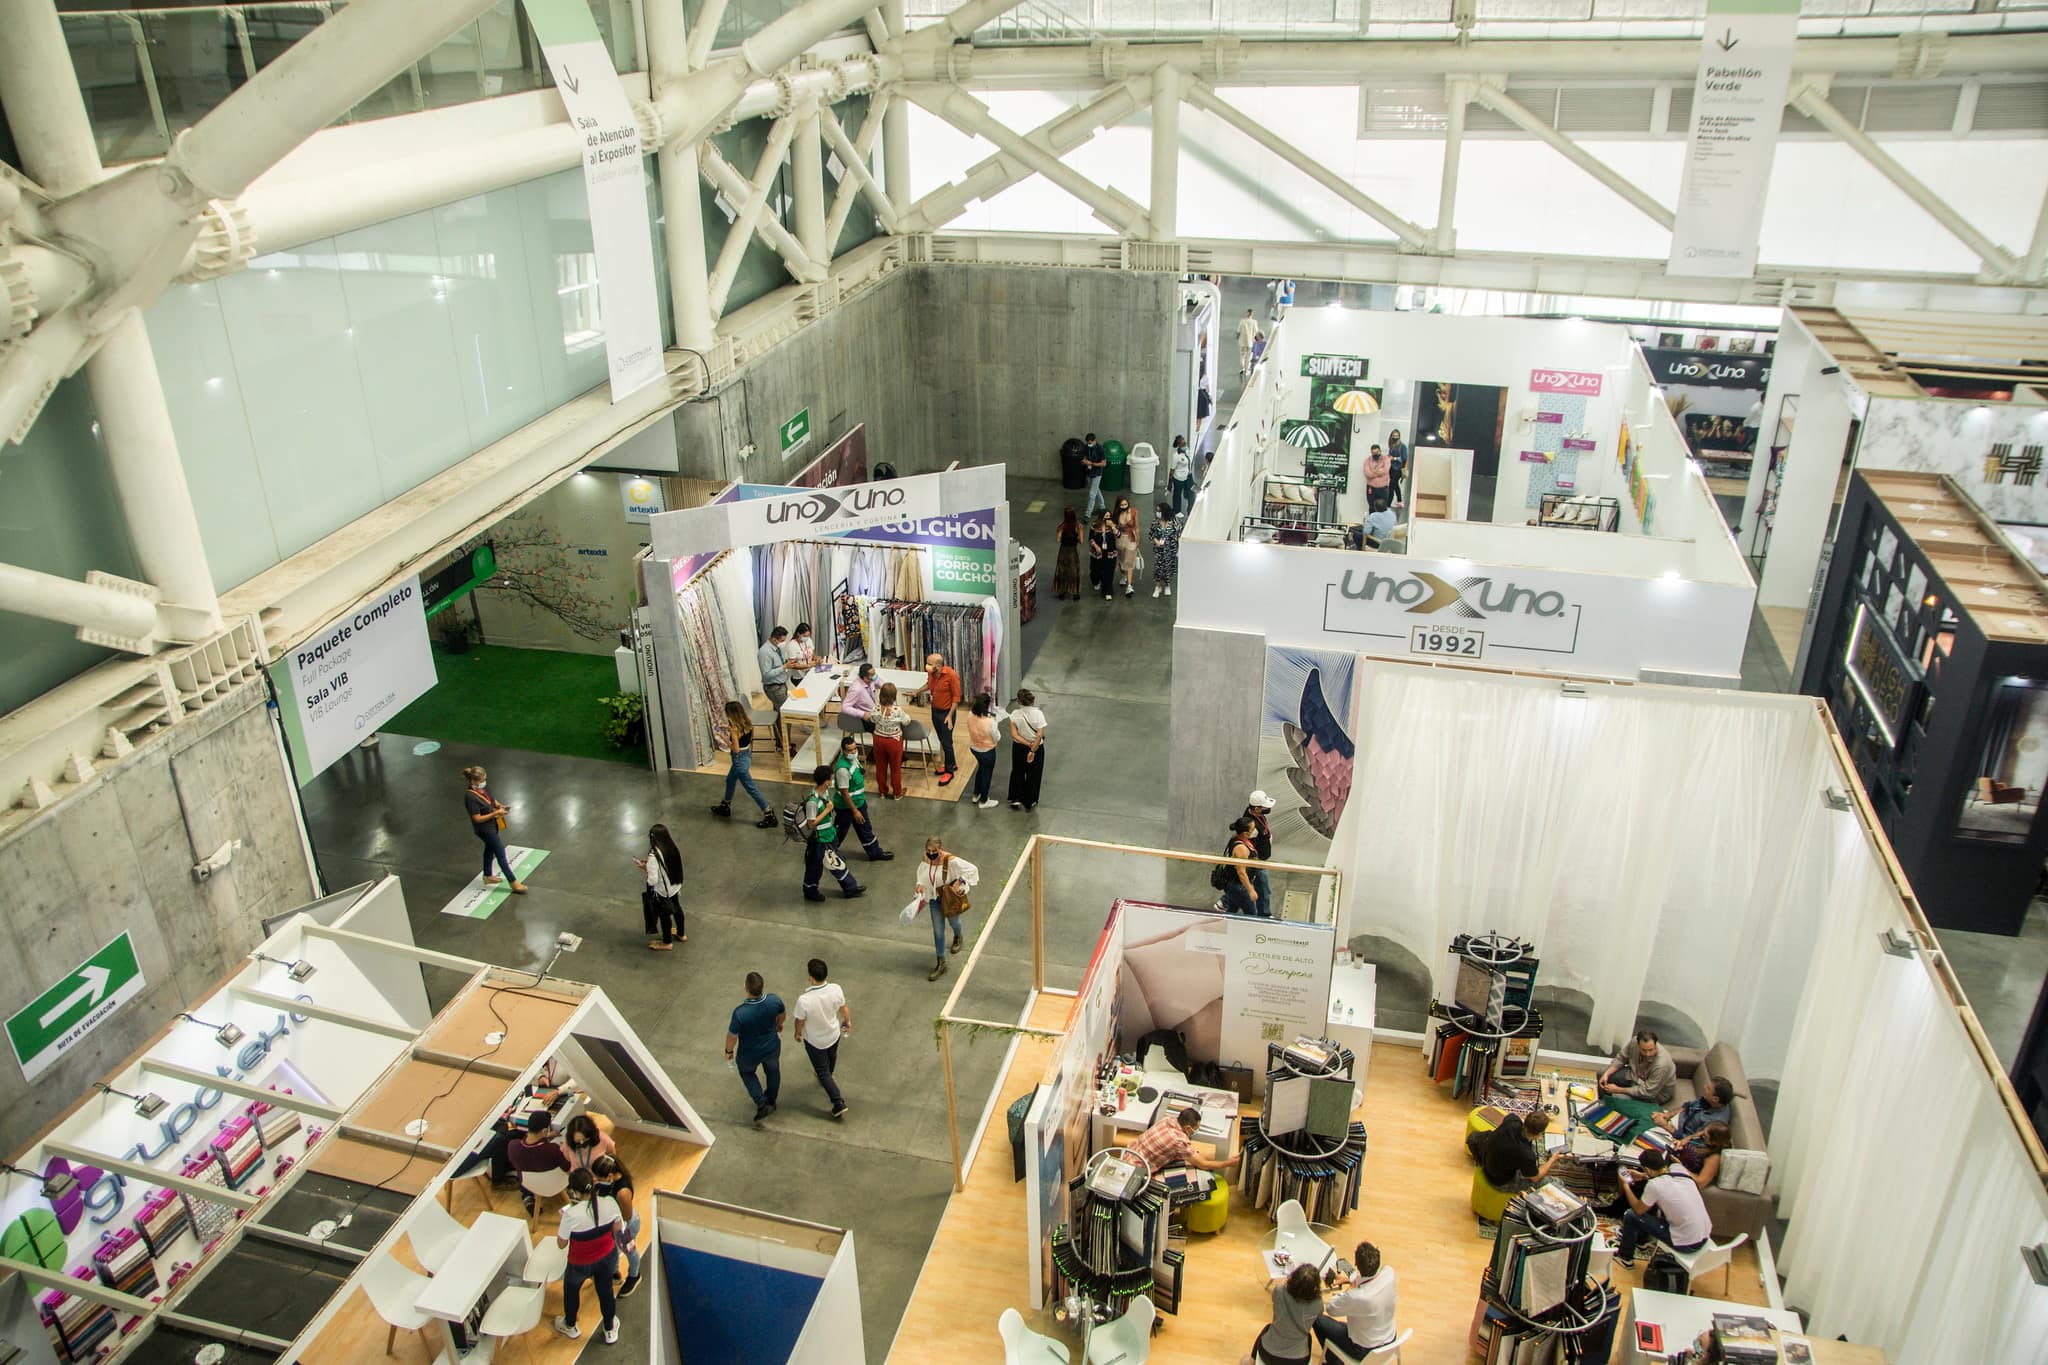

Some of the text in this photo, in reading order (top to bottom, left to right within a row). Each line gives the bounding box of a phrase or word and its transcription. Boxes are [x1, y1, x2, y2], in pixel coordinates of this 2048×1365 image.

[1706, 67, 1762, 79] Pabellón
[1705, 81, 1742, 91] Verde
[577, 116, 599, 129] Sala
[587, 126, 636, 146] de Atención
[590, 144, 637, 165] al Expositor
[1309, 357, 1363, 377] SUNTECH
[629, 505, 659, 514] artextil
[936, 560, 981, 572] FORRO
[297, 626, 352, 670] Paquete
[354, 587, 412, 631] Completo
[1432, 624, 1465, 635] DESDE
[1418, 632, 1476, 655] 1992
[302, 648, 352, 687] Full Package
[306, 671, 349, 709] Sala VIB
[309, 687, 353, 723] VIB Lounge
[1282, 954, 1293, 962] DE
[1294, 956, 1314, 965] ALTO
[57, 999, 116, 1050] RUTA DE EVACUACIÓN
